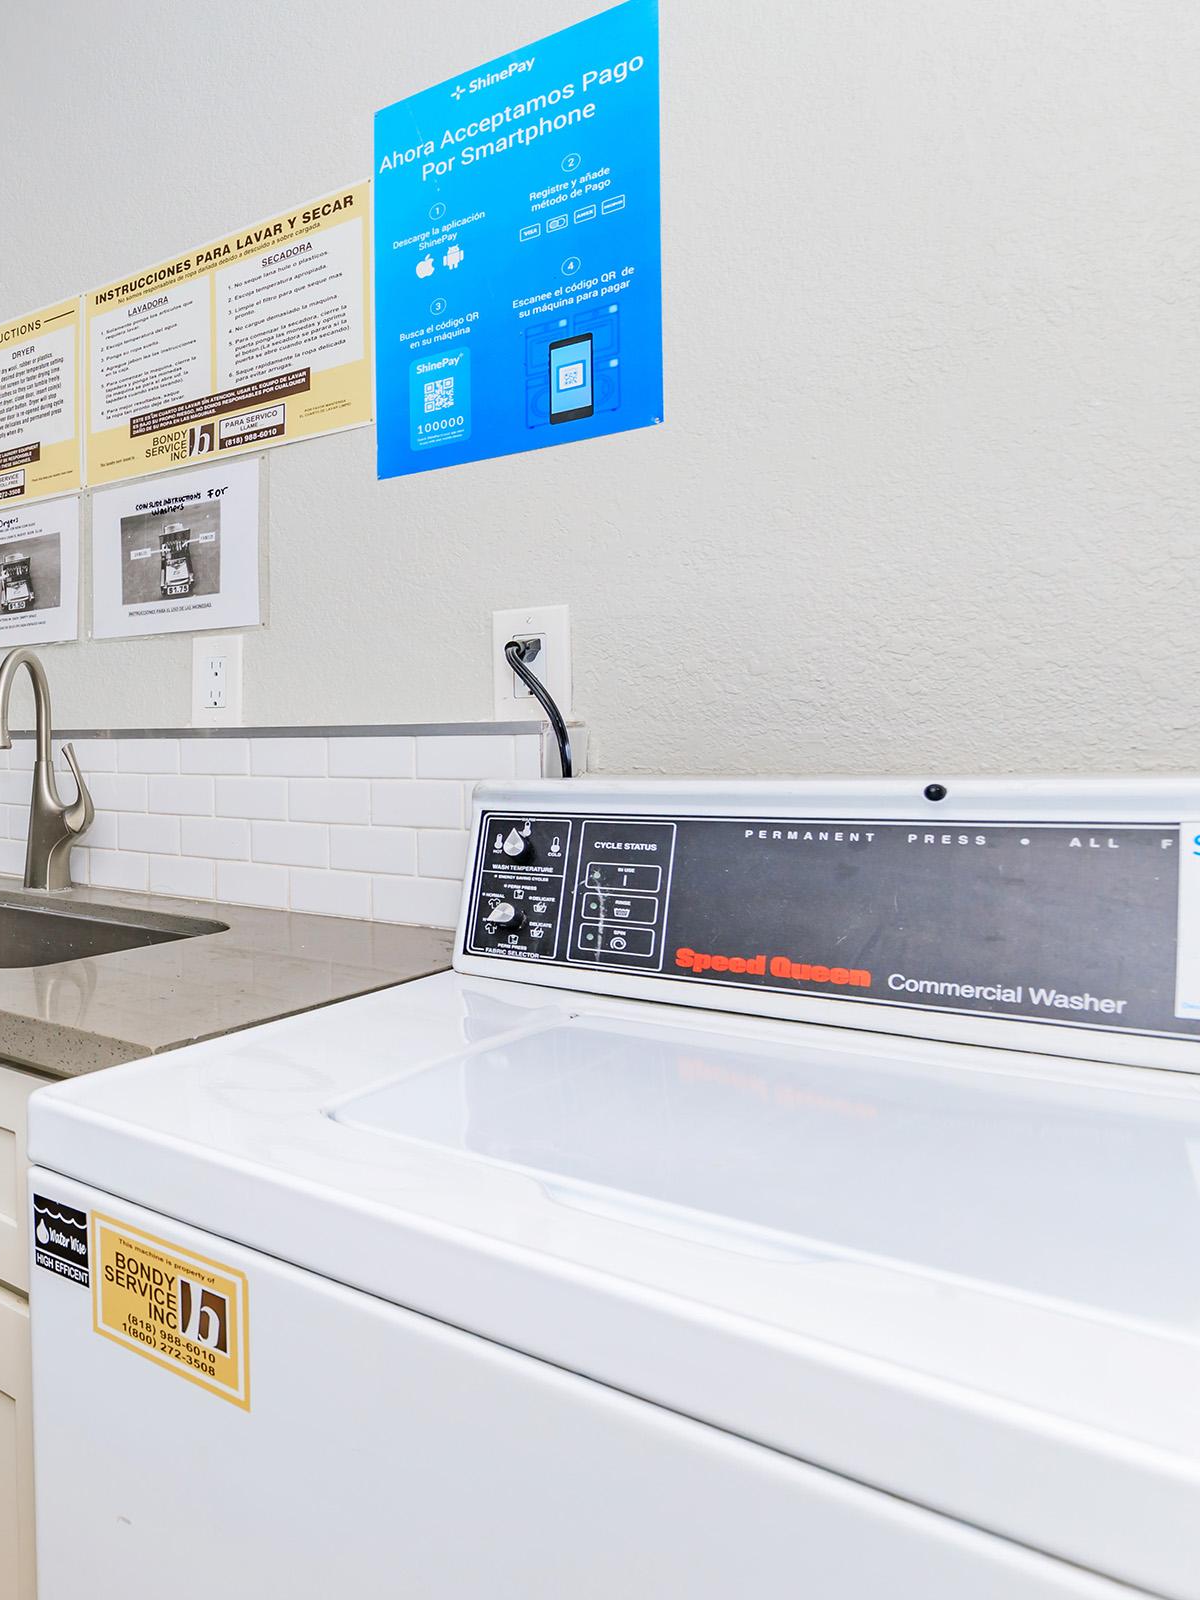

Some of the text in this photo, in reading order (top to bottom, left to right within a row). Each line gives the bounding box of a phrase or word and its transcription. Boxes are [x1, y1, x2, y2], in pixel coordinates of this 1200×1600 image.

[469, 57, 535, 93] ShinePay
[379, 55, 644, 174] Ahora Acceptamos Pago
[421, 103, 596, 181] Por Smartphone
[567, 158, 575, 167] 2
[529, 167, 610, 202] Registre y añade
[531, 179, 611, 212] método de Pago
[393, 211, 485, 250] Descarge la aplicación
[95, 195, 353, 304] INSTRUCCIONES PARA LAVAR Y SECAR
[419, 232, 457, 251] ShinePay
[143, 278, 176, 293] responsables
[184, 270, 196, 278] ropa
[218, 254, 237, 265] debido
[243, 241, 269, 255] descuido
[276, 232, 293, 243] sobre
[295, 222, 320, 235] cargada
[261, 242, 312, 266] SECADORA
[567, 261, 574, 270] 4
[512, 266, 635, 309] Escanee el código QR de
[127, 296, 168, 316] LAVADORA
[435, 302, 441, 311] 3
[518, 280, 631, 319] su máquina para pagar
[400, 312, 479, 341] Busca el código QR
[422, 338, 432, 346] su
[434, 326, 471, 342] máquina
[11, 345, 35, 359] DRYER
[416, 357, 460, 374] ShinePay
[224, 409, 277, 428] PARA SERVICO
[239, 421, 257, 431] LLAME
[417, 415, 464, 434] 100000
[152, 429, 188, 446] BONDY
[224, 428, 276, 446] (818) 988-6010
[145, 440, 187, 457] SERVICE
[170, 449, 187, 461] INC
[168, 586, 188, 594] $1.75
[594, 841, 657, 851] CYCLE STATUS
[744, 829, 1120, 850] PERMANENT PRESS ALL
[510, 865, 554, 873] TEMPERATURE
[485, 947, 540, 959] FABRIC SELECTOR
[675, 947, 872, 988] Speed Queen
[887, 973, 1127, 1015] Commercial Washer
[49, 1227, 70, 1248] Water
[37, 1252, 54, 1269] HIGH
[115, 1252, 175, 1290] BONDY
[118, 1238, 133, 1248] This
[134, 1244, 164, 1263] machine
[174, 1262, 205, 1280] property
[207, 1276, 215, 1285] of
[105, 1265, 177, 1312] SERVICE
[148, 1303, 177, 1330] INC
[127, 1313, 216, 1364] (818) 988-6010
[122, 1323, 216, 1376] 1(800) 272-3508
